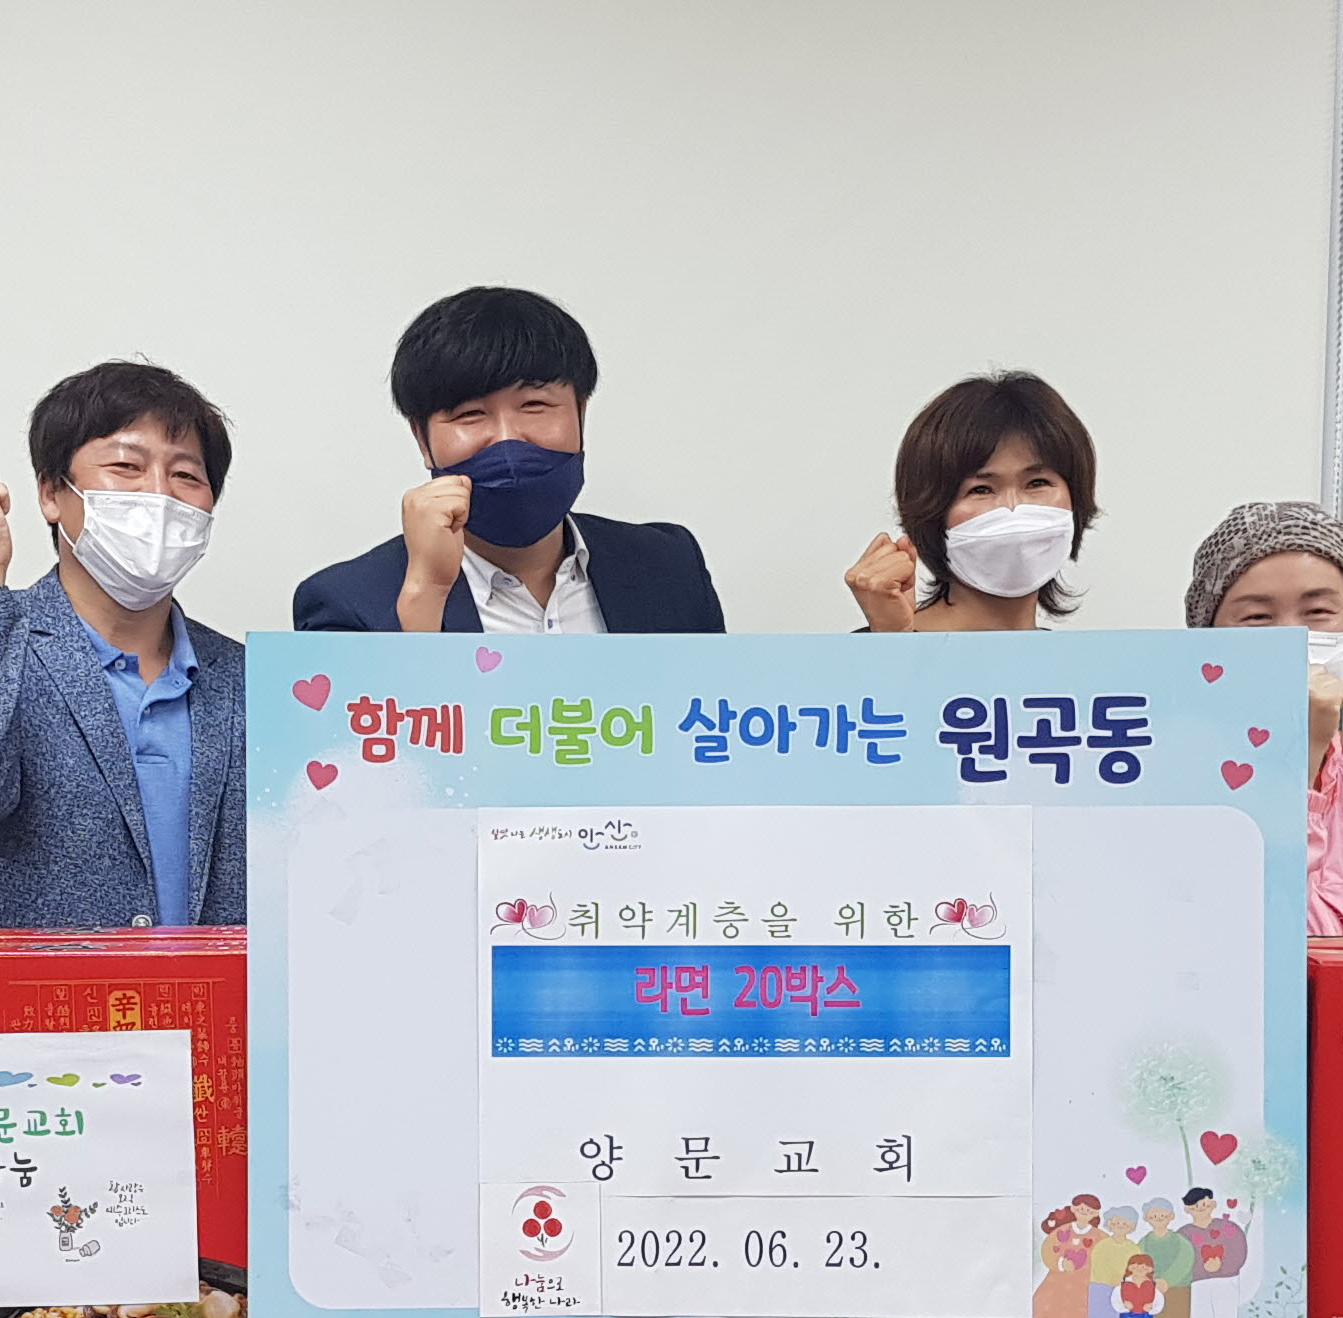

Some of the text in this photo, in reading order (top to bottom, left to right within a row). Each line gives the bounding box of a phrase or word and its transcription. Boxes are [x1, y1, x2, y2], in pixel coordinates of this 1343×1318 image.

[346, 695, 1153, 785] 함께 더불어 살아가는 원곡동
[567, 900, 919, 940] 취약계층을 위한
[634, 964, 862, 1017] 라면 20박스
[616, 1229, 881, 1269] 2022. 06. 23.
